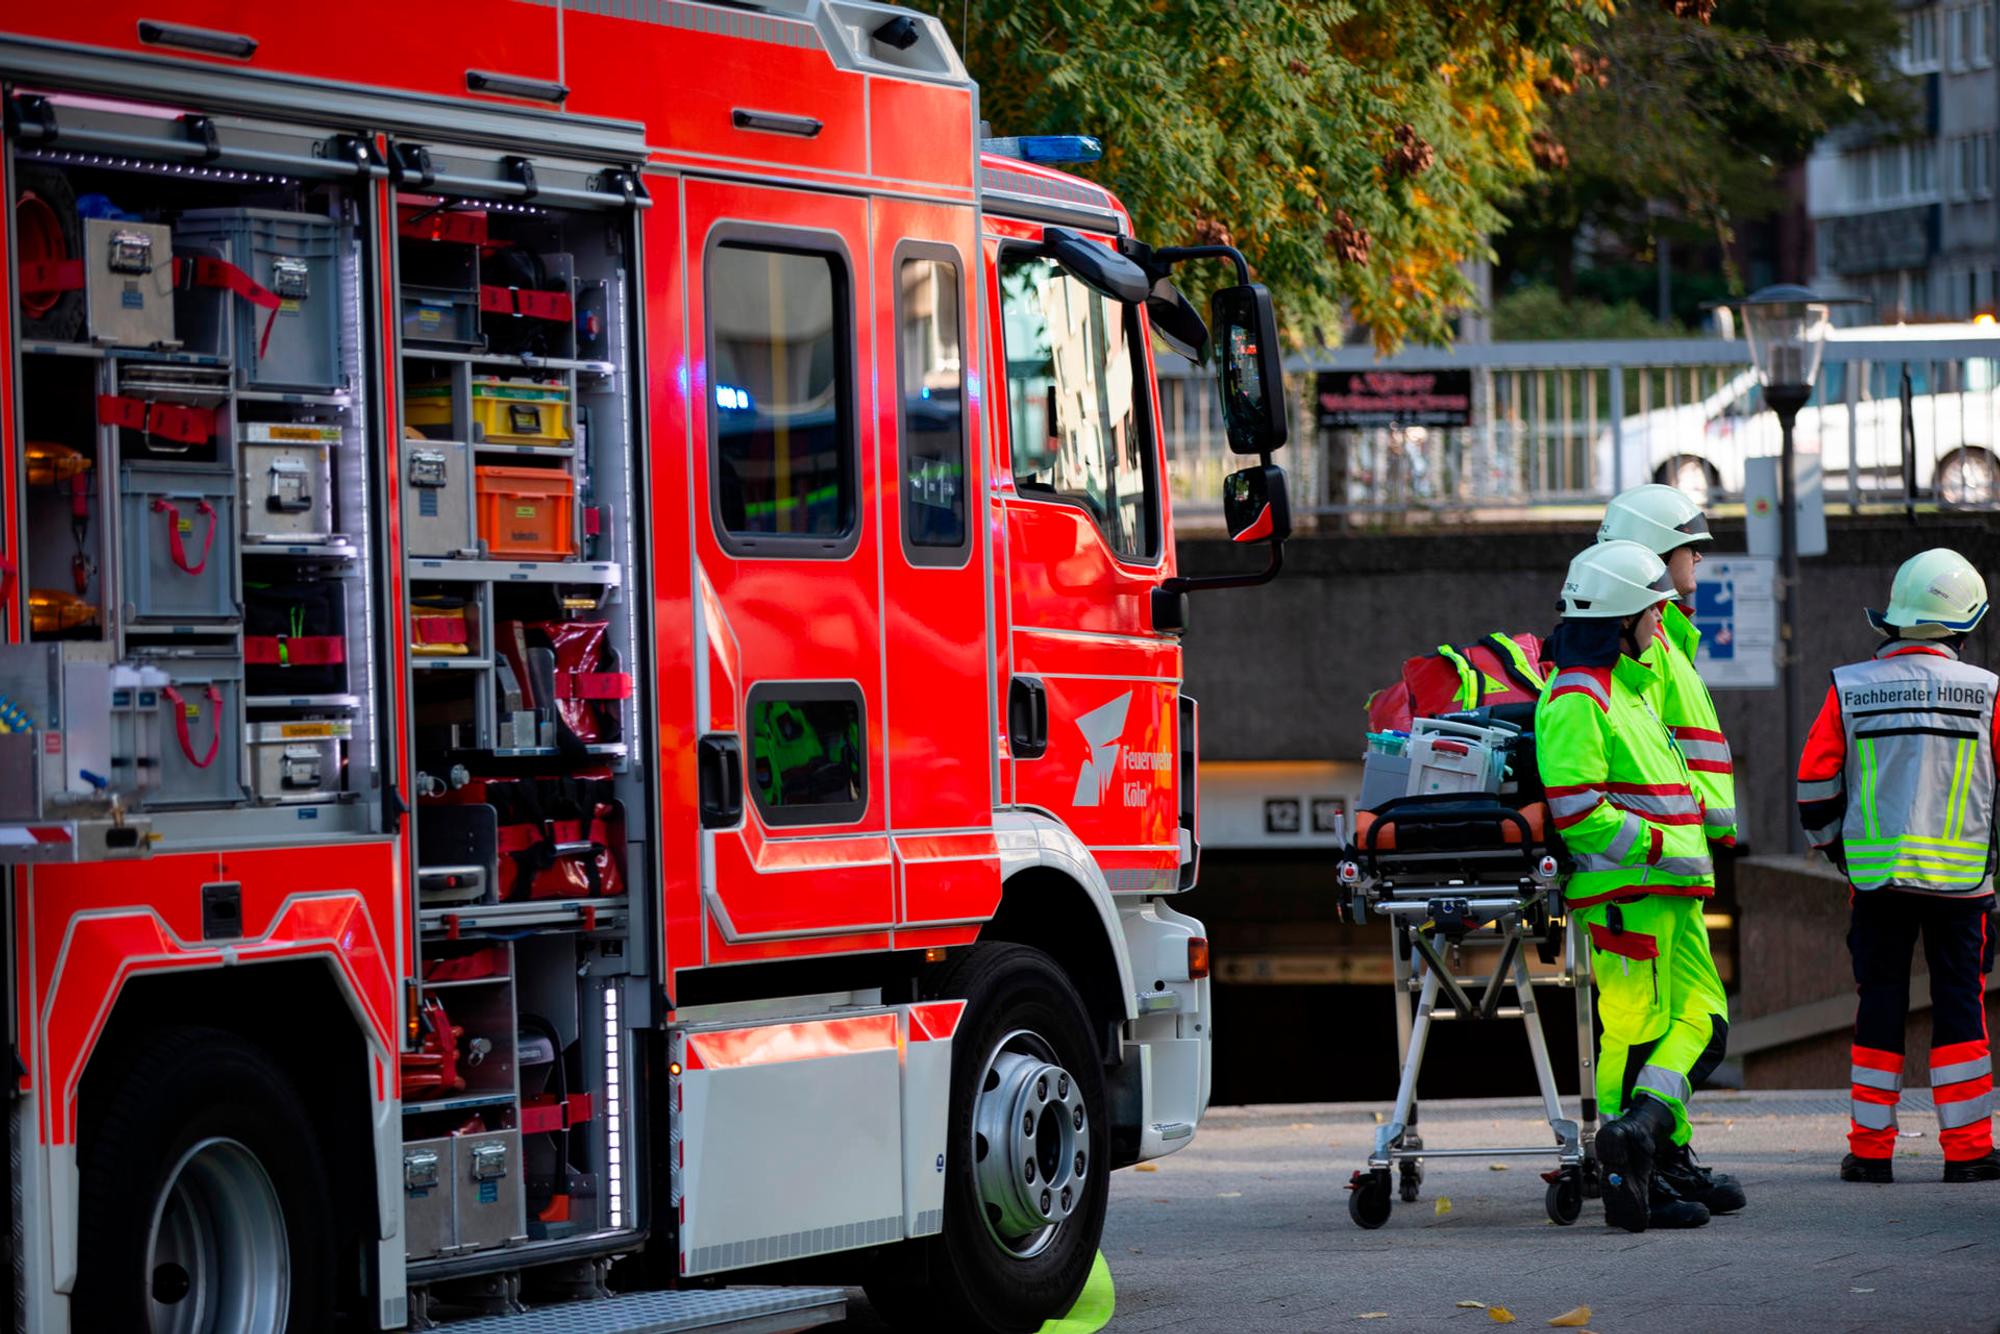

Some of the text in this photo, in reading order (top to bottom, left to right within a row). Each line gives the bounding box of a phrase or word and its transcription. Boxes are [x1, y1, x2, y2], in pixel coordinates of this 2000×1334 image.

[1844, 686, 1985, 706] Fachberater HIORG
[1123, 745, 1172, 770] Feuerwehr
[1123, 781, 1147, 807] Köln
